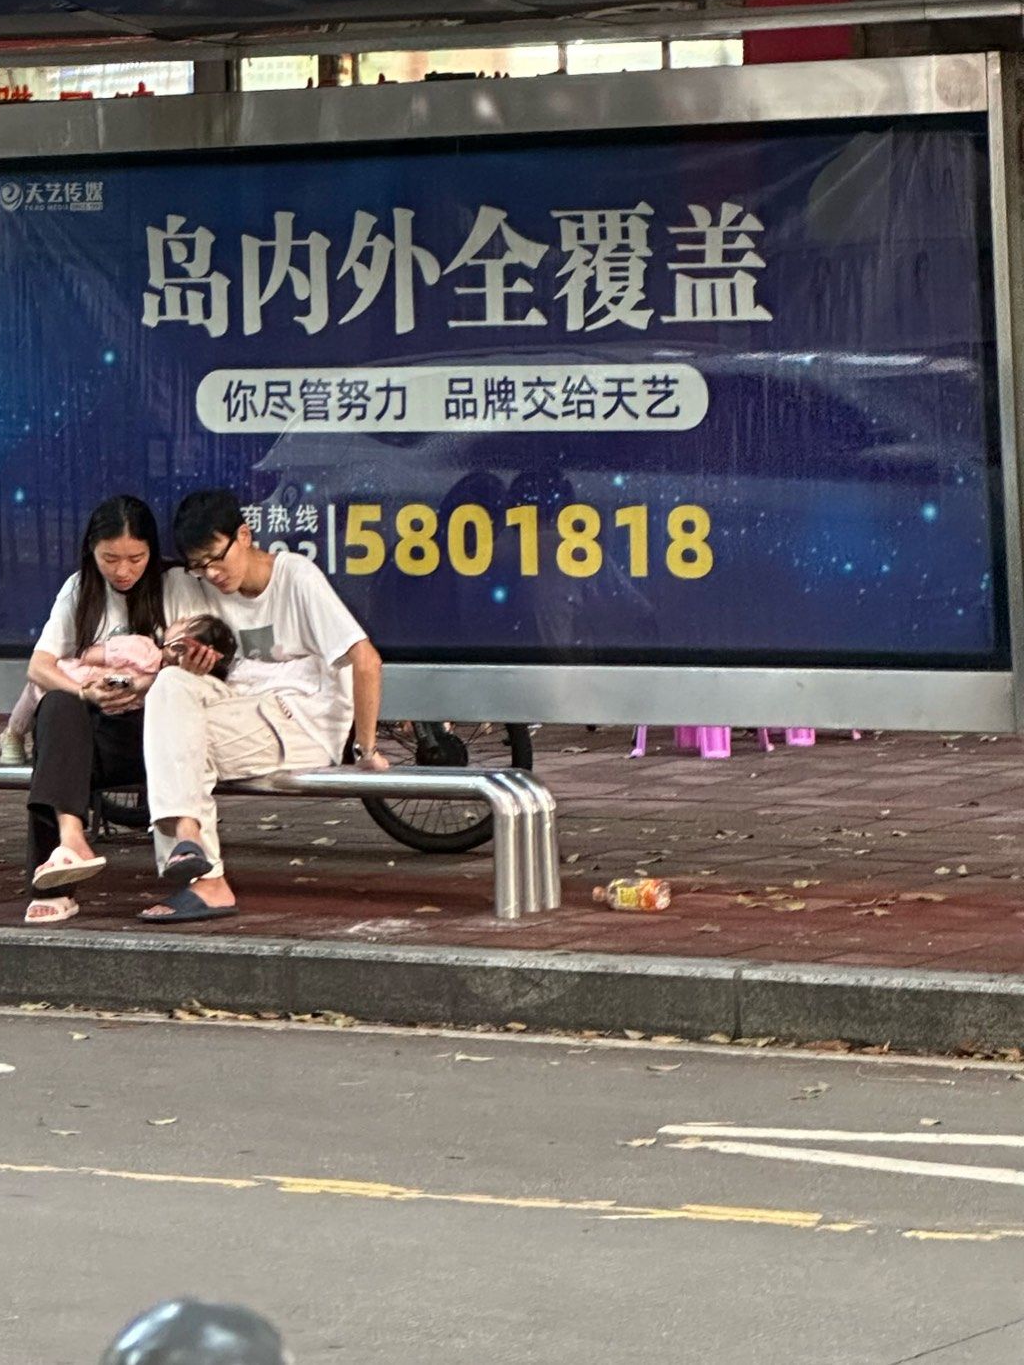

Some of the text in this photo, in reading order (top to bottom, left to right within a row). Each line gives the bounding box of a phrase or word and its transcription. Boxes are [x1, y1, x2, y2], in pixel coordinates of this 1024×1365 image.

[25, 182, 103, 203] 天艺传媒
[140, 201, 775, 339] 岛内外全覆盖
[222, 373, 683, 424] 你尽管努力 品牌交给天艺
[344, 503, 715, 580] 5801818
